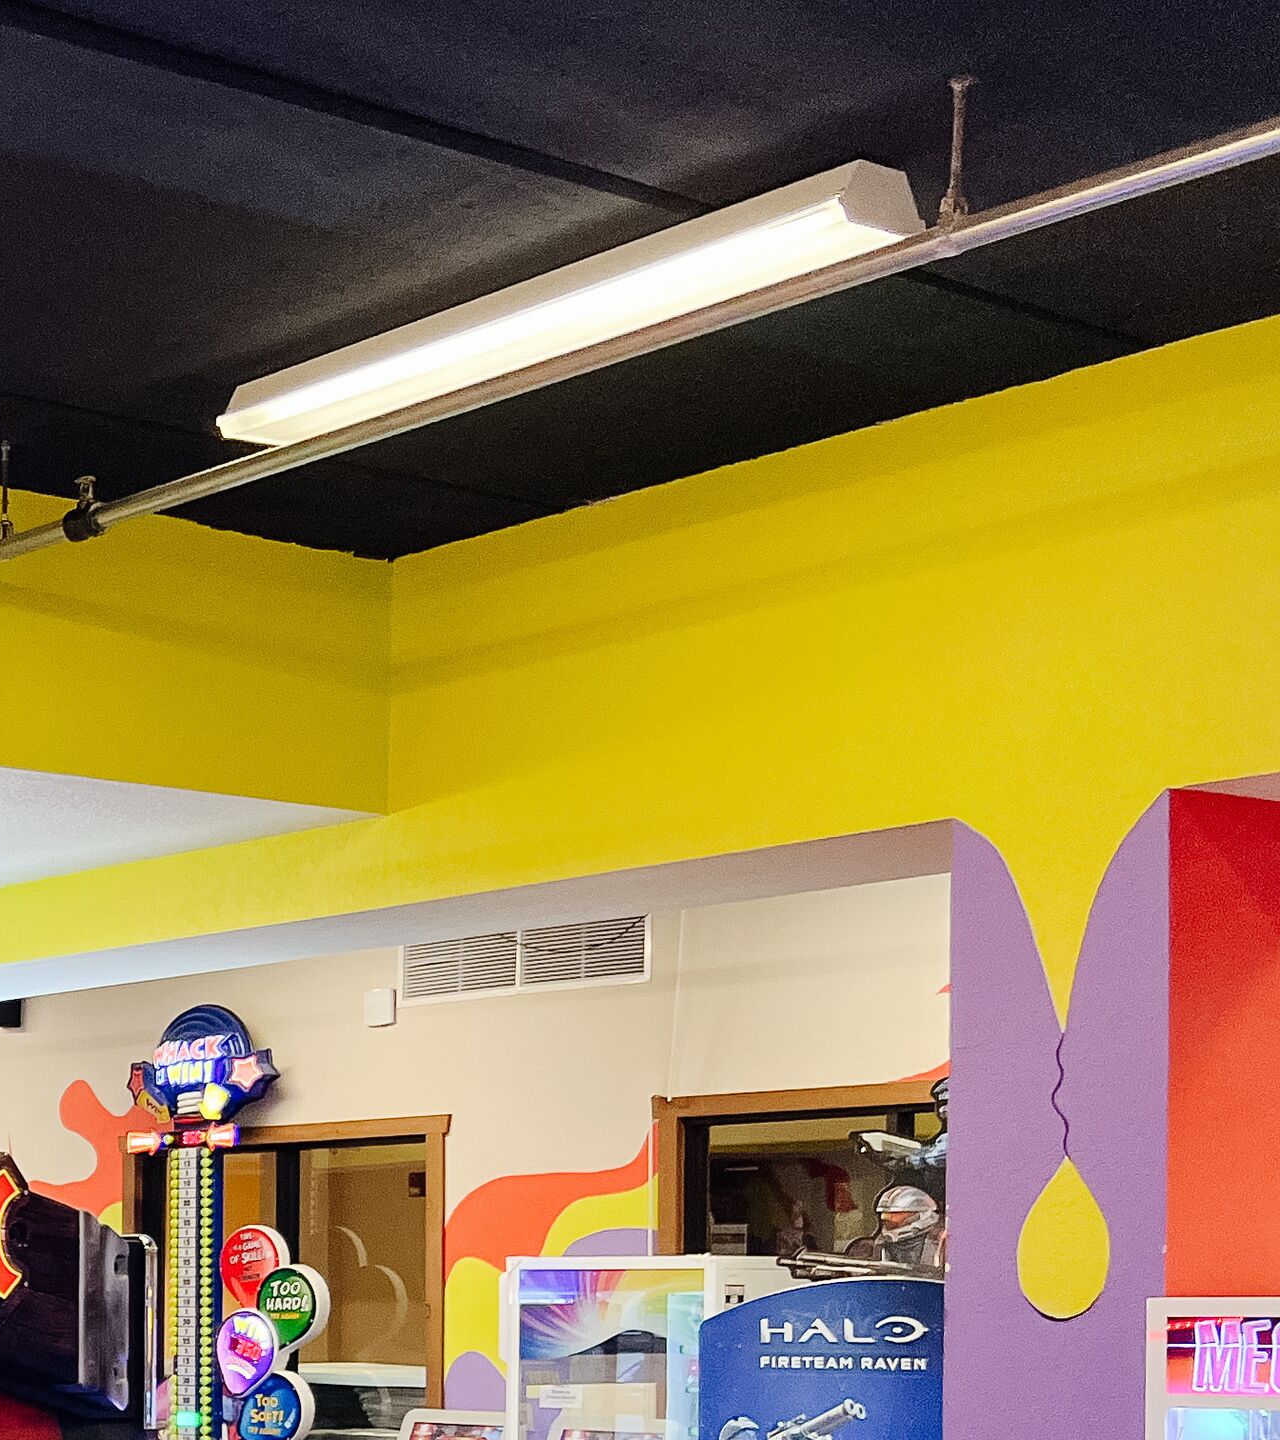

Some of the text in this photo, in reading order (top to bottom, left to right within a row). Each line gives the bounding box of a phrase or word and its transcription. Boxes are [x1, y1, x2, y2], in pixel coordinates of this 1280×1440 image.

[270, 1280, 301, 1297] TOO
[266, 1295, 309, 1311] HARD!
[759, 1315, 929, 1344] HALO
[759, 1355, 928, 1371] FIRETEAM RAVEN
